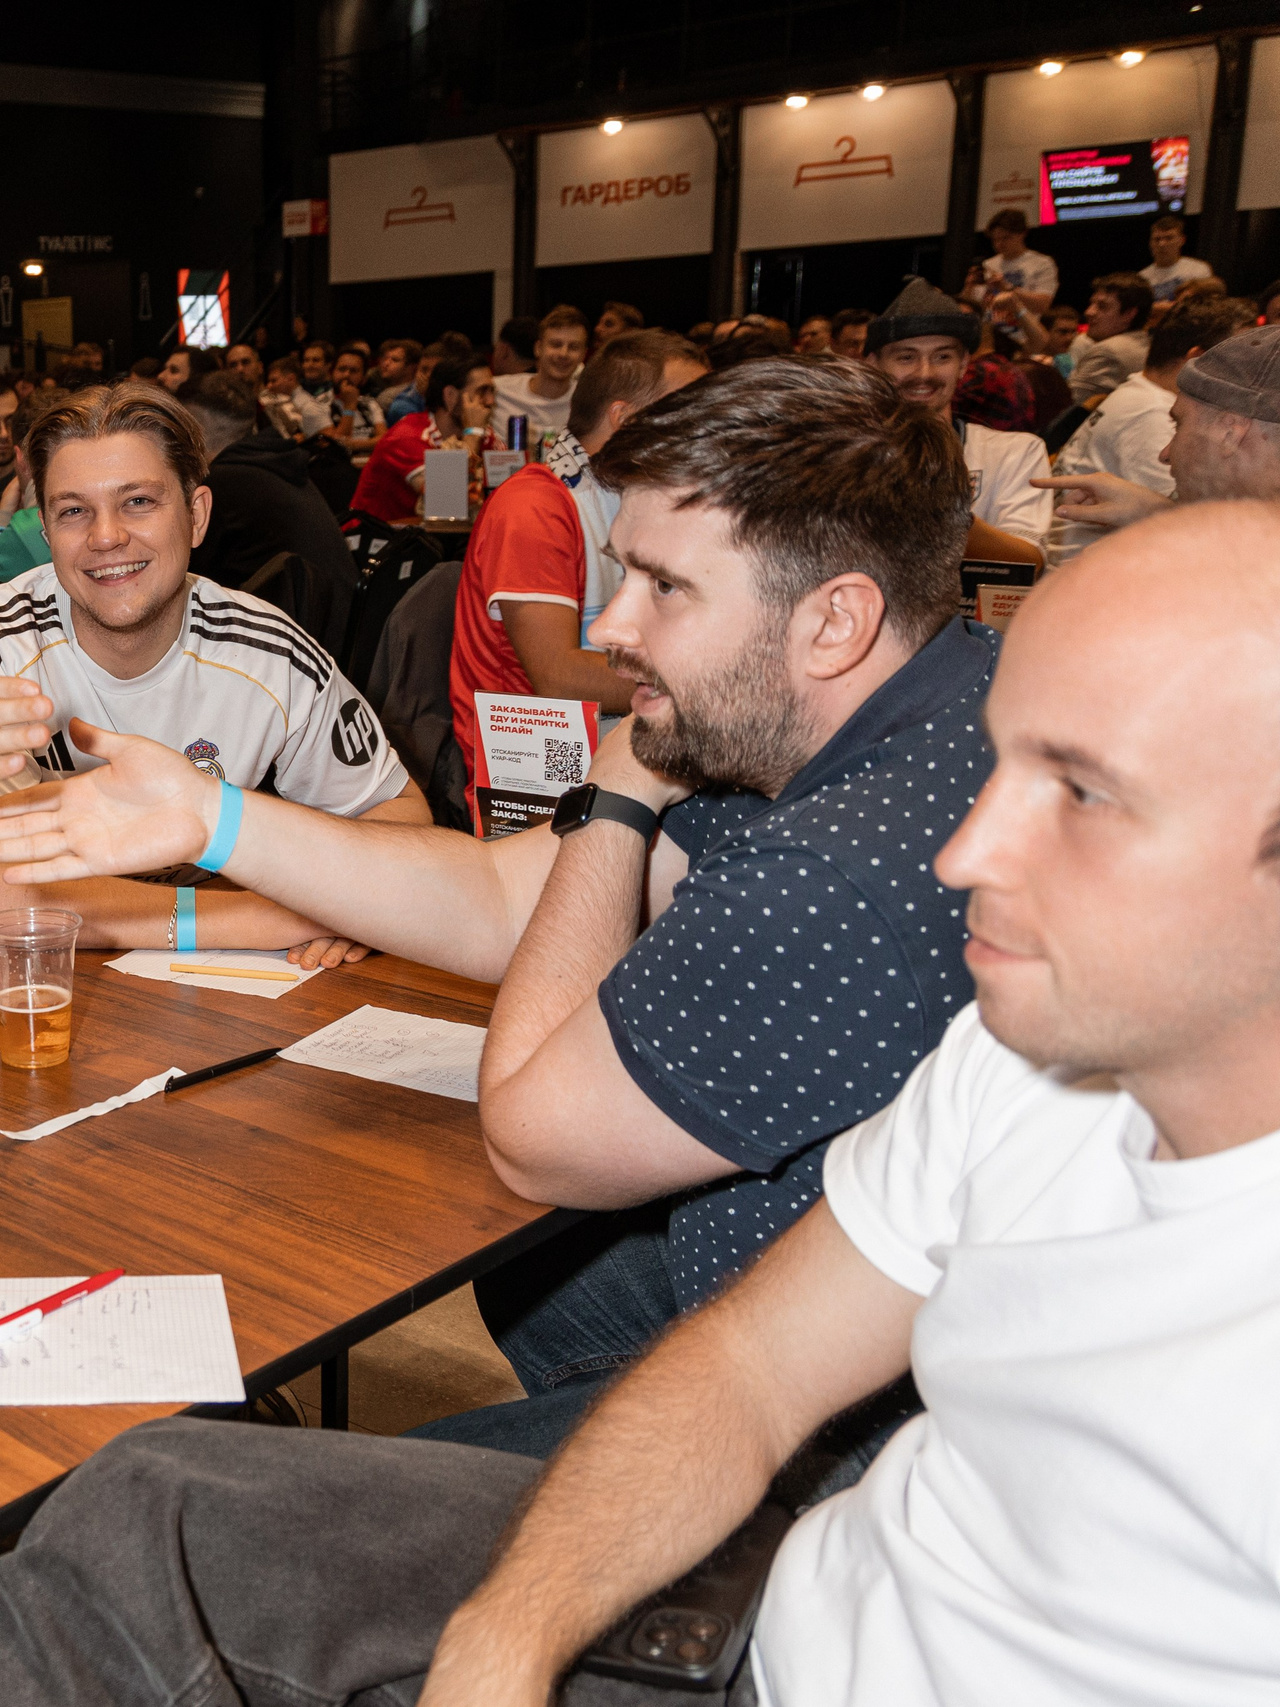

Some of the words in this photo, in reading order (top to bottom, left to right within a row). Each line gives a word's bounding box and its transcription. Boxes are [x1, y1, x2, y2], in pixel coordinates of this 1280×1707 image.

[560, 172, 692, 208] ГАРДЕРОБ
[490, 704, 566, 719] ЗАКАЗЫВАЙТЕ
[490, 715, 509, 724] ЕДУ
[520, 718, 569, 729] НАПИТКИ
[337, 702, 373, 763] hp
[490, 725, 533, 735] ОНЛАЙН
[491, 748, 539, 759] ОТСКАНИРУЙТЕ
[490, 800, 527, 811] ЧТОБЫ
[490, 809, 528, 821] ЗАКАЗ:
